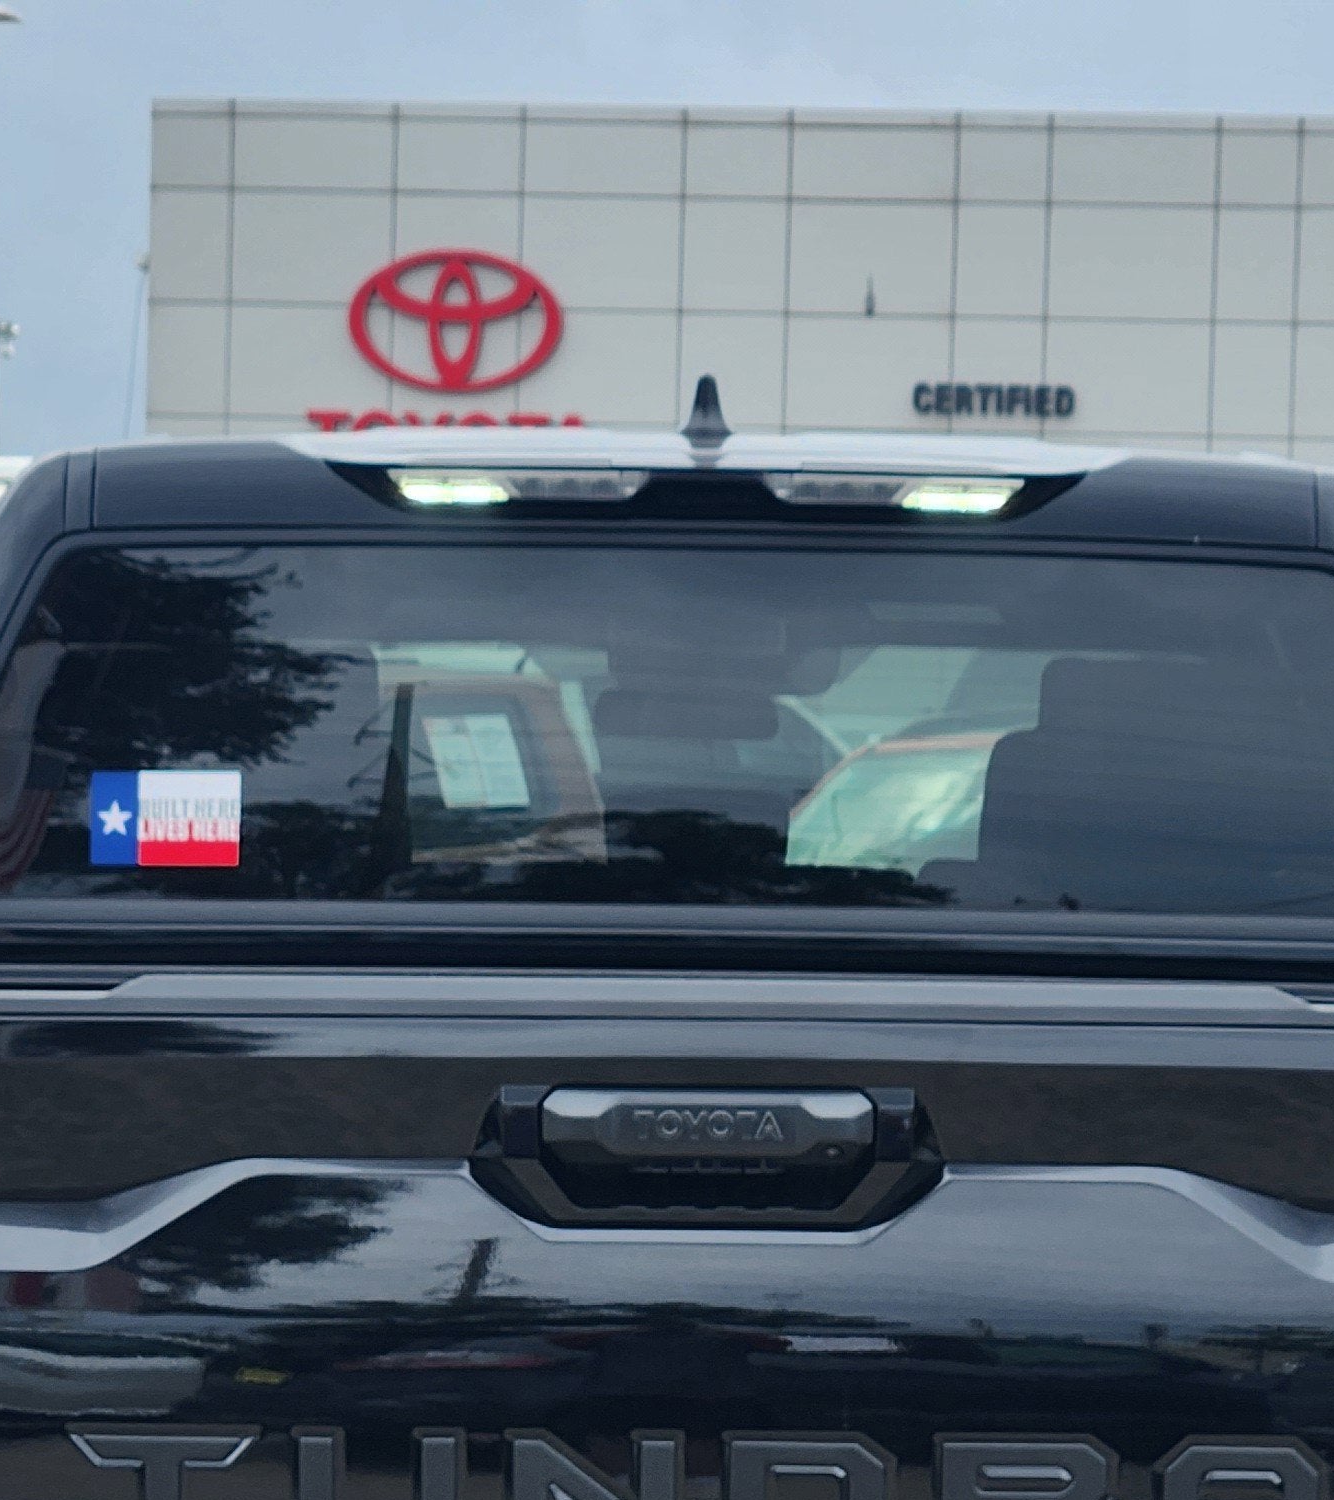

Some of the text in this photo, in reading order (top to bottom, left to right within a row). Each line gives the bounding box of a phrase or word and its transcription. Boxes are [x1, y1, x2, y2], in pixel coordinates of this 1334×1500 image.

[913, 382, 1075, 417] CERTIFIED
[194, 798, 240, 818] HERE
[192, 818, 239, 842] HERE
[633, 1109, 784, 1140] TOYOTA
